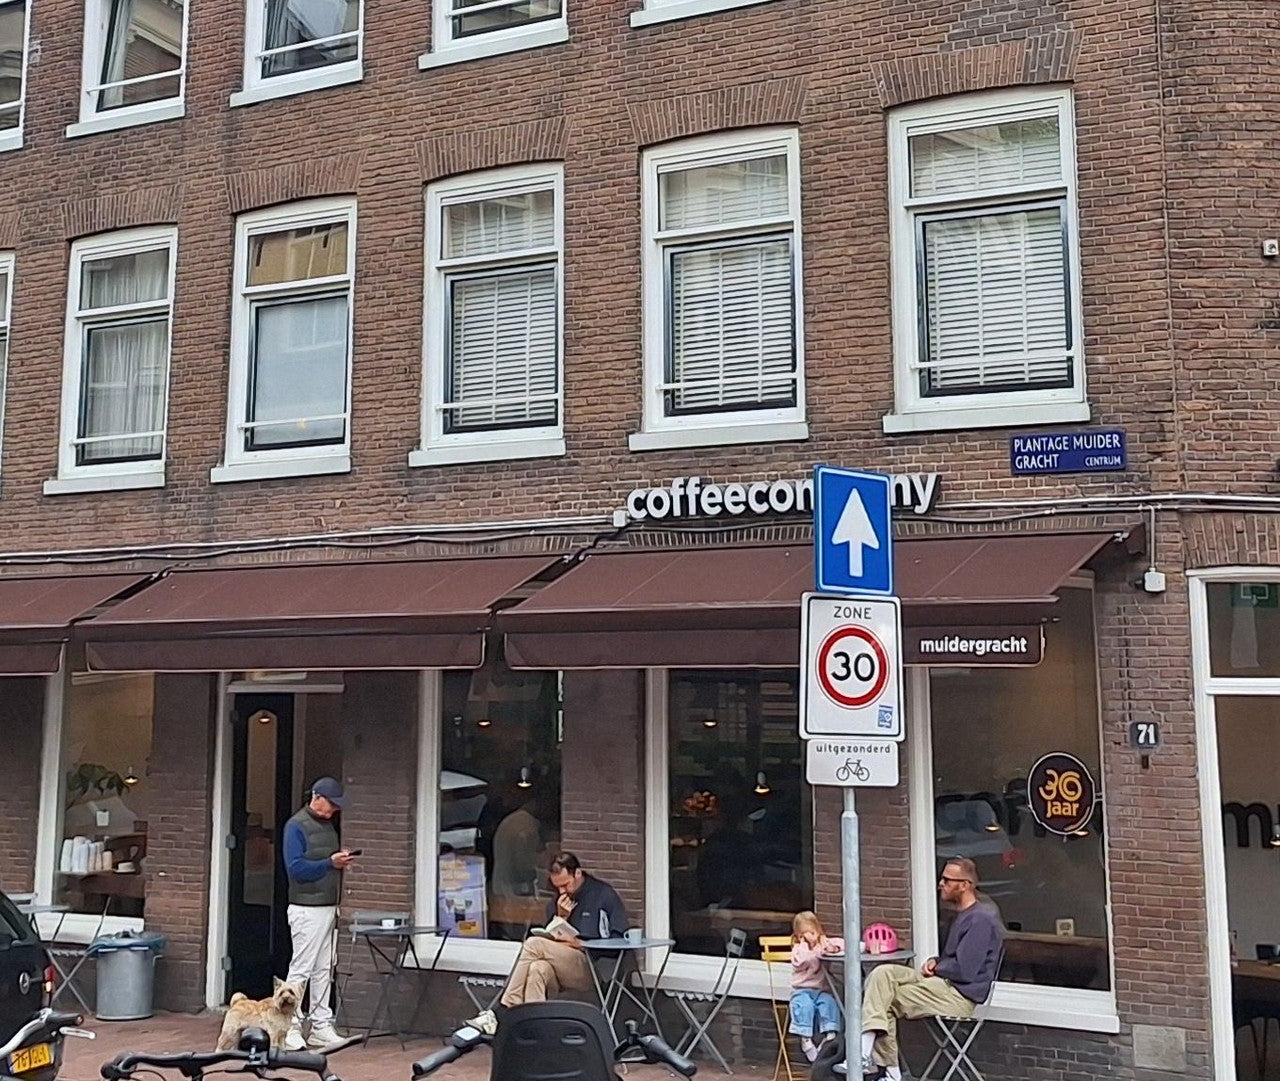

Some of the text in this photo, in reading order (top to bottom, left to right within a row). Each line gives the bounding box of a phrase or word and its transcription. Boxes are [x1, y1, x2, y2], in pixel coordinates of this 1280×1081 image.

[1014, 434, 1121, 452] PLANTAGE MUIDER
[1015, 454, 1059, 469] GRACHT
[1085, 456, 1121, 466] CENTRUM
[627, 473, 937, 519] coffeecony
[833, 606, 872, 619] ZONE
[920, 636, 1027, 655] muidergracht
[831, 651, 875, 682] 30
[1137, 723, 1156, 744] 71
[816, 743, 891, 755] uitgezonderd
[1039, 769, 1082, 801] 30
[1045, 801, 1079, 818] jaar
